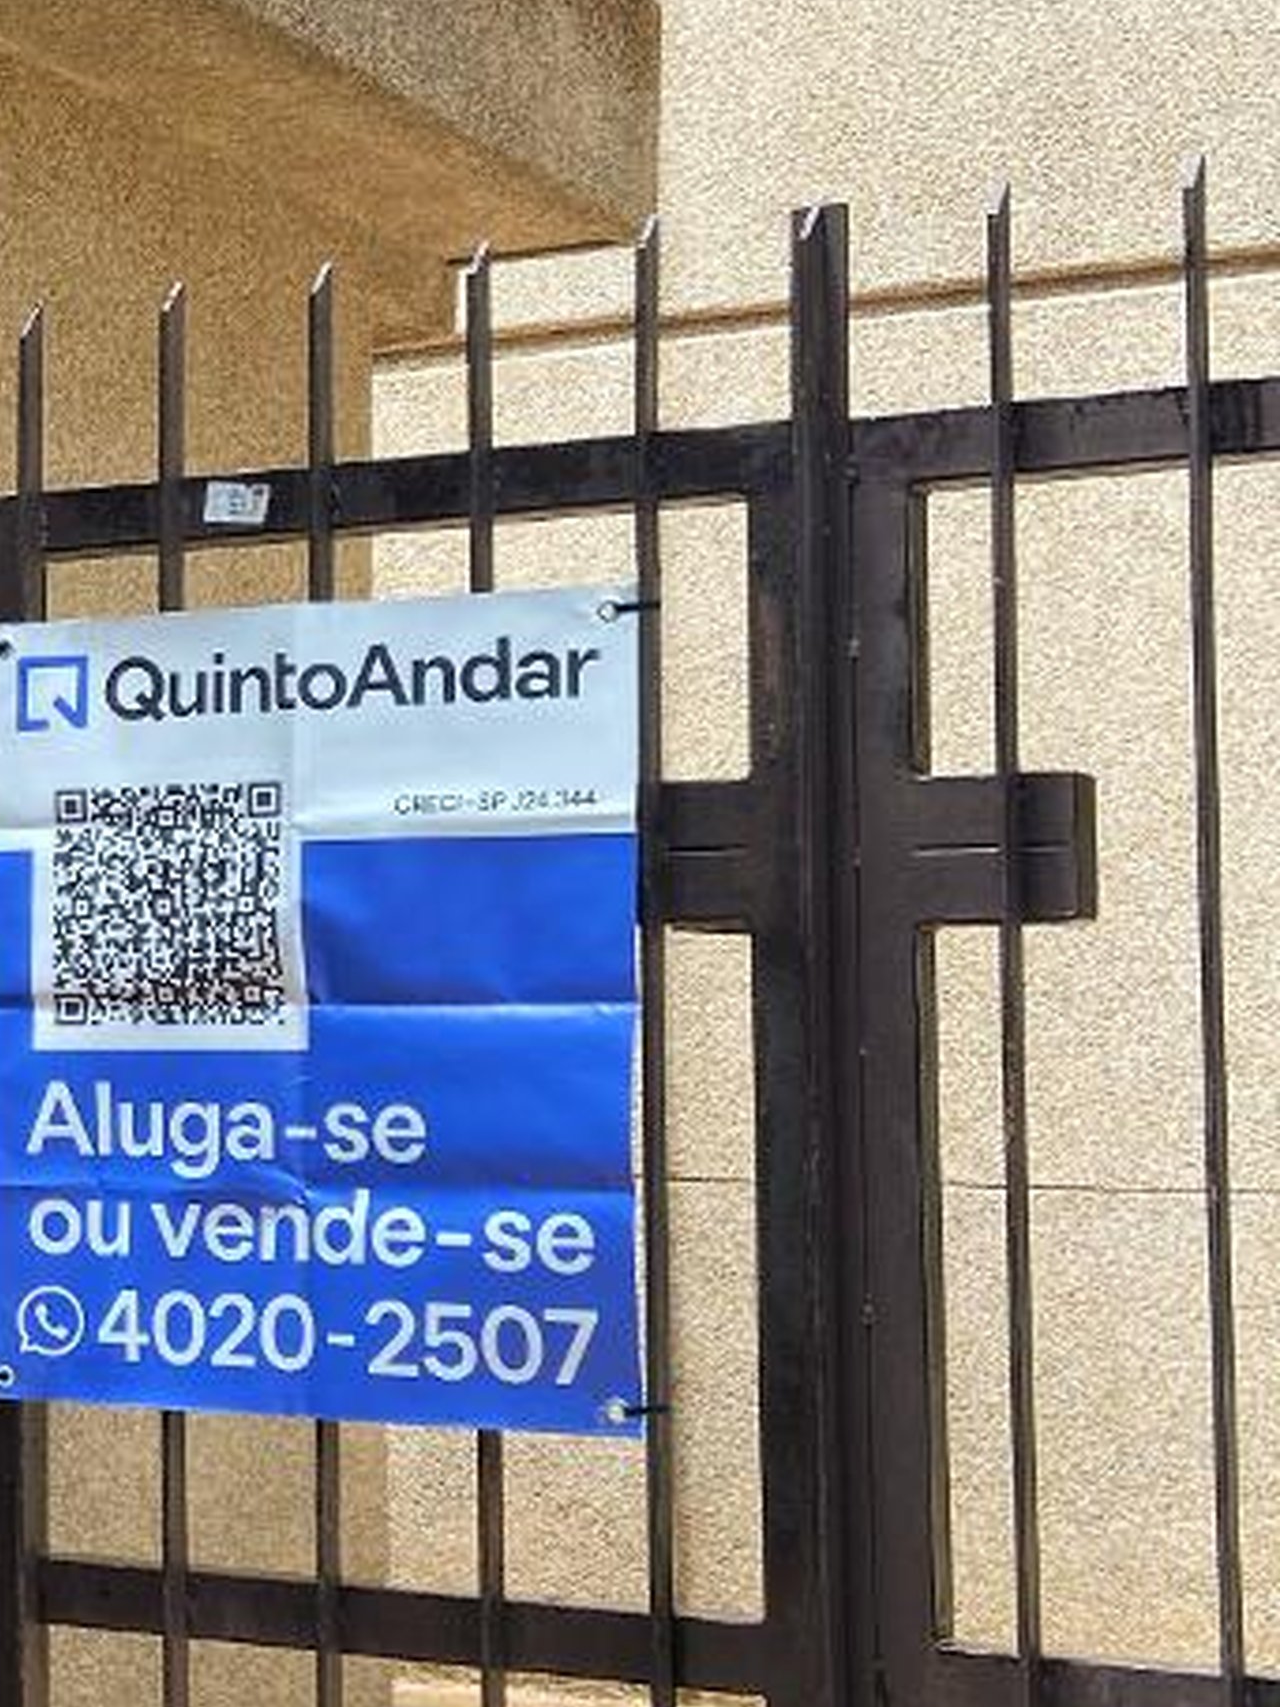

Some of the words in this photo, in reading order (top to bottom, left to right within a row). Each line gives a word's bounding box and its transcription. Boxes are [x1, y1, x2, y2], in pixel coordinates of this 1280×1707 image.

[104, 636, 600, 722] QuintoAndar
[25, 1080, 428, 1178] Aluga-se
[28, 1197, 132, 1257] ou
[151, 1188, 596, 1275] vende-se
[96, 1289, 600, 1386] 4020-2507
